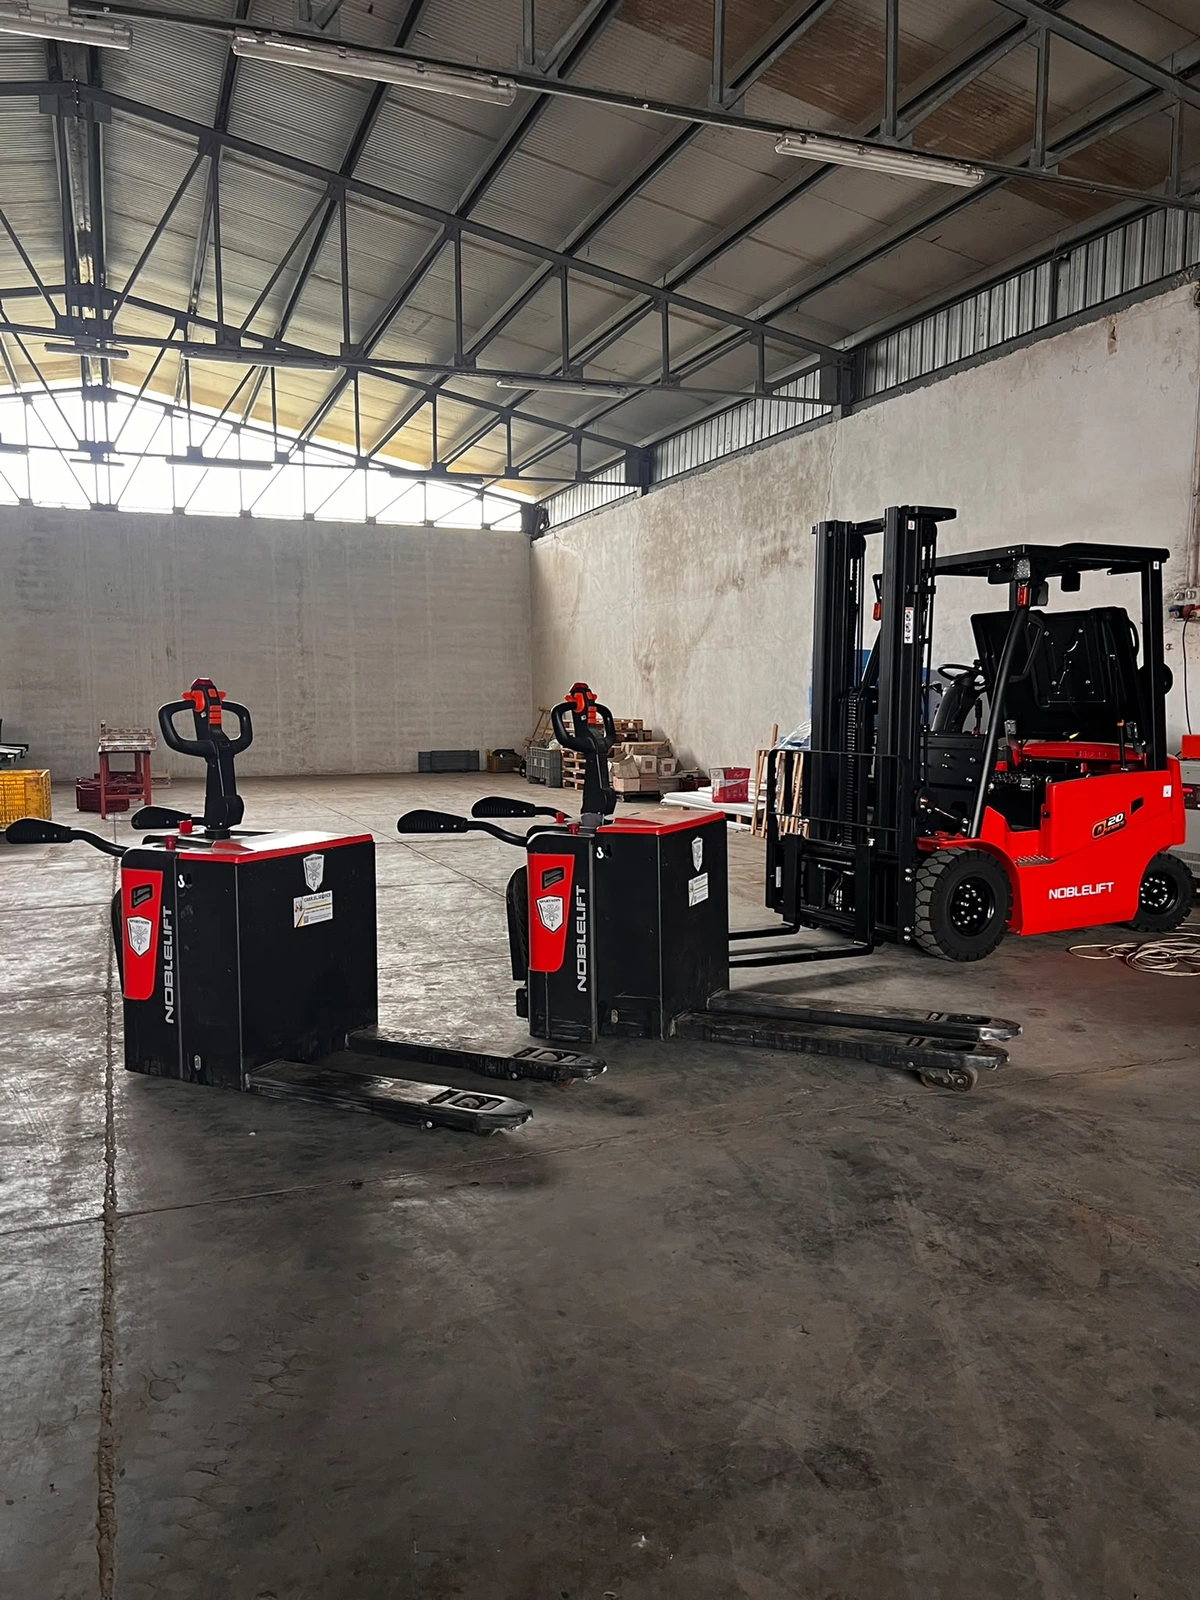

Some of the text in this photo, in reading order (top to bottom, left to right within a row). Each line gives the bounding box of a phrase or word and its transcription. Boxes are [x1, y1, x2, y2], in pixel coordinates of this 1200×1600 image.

[1107, 813, 1124, 826] 20
[1049, 881, 1115, 900] NOBLELIFT
[162, 905, 174, 1024] NOBLELIFT
[576, 885, 587, 992] NOBLELIFT
